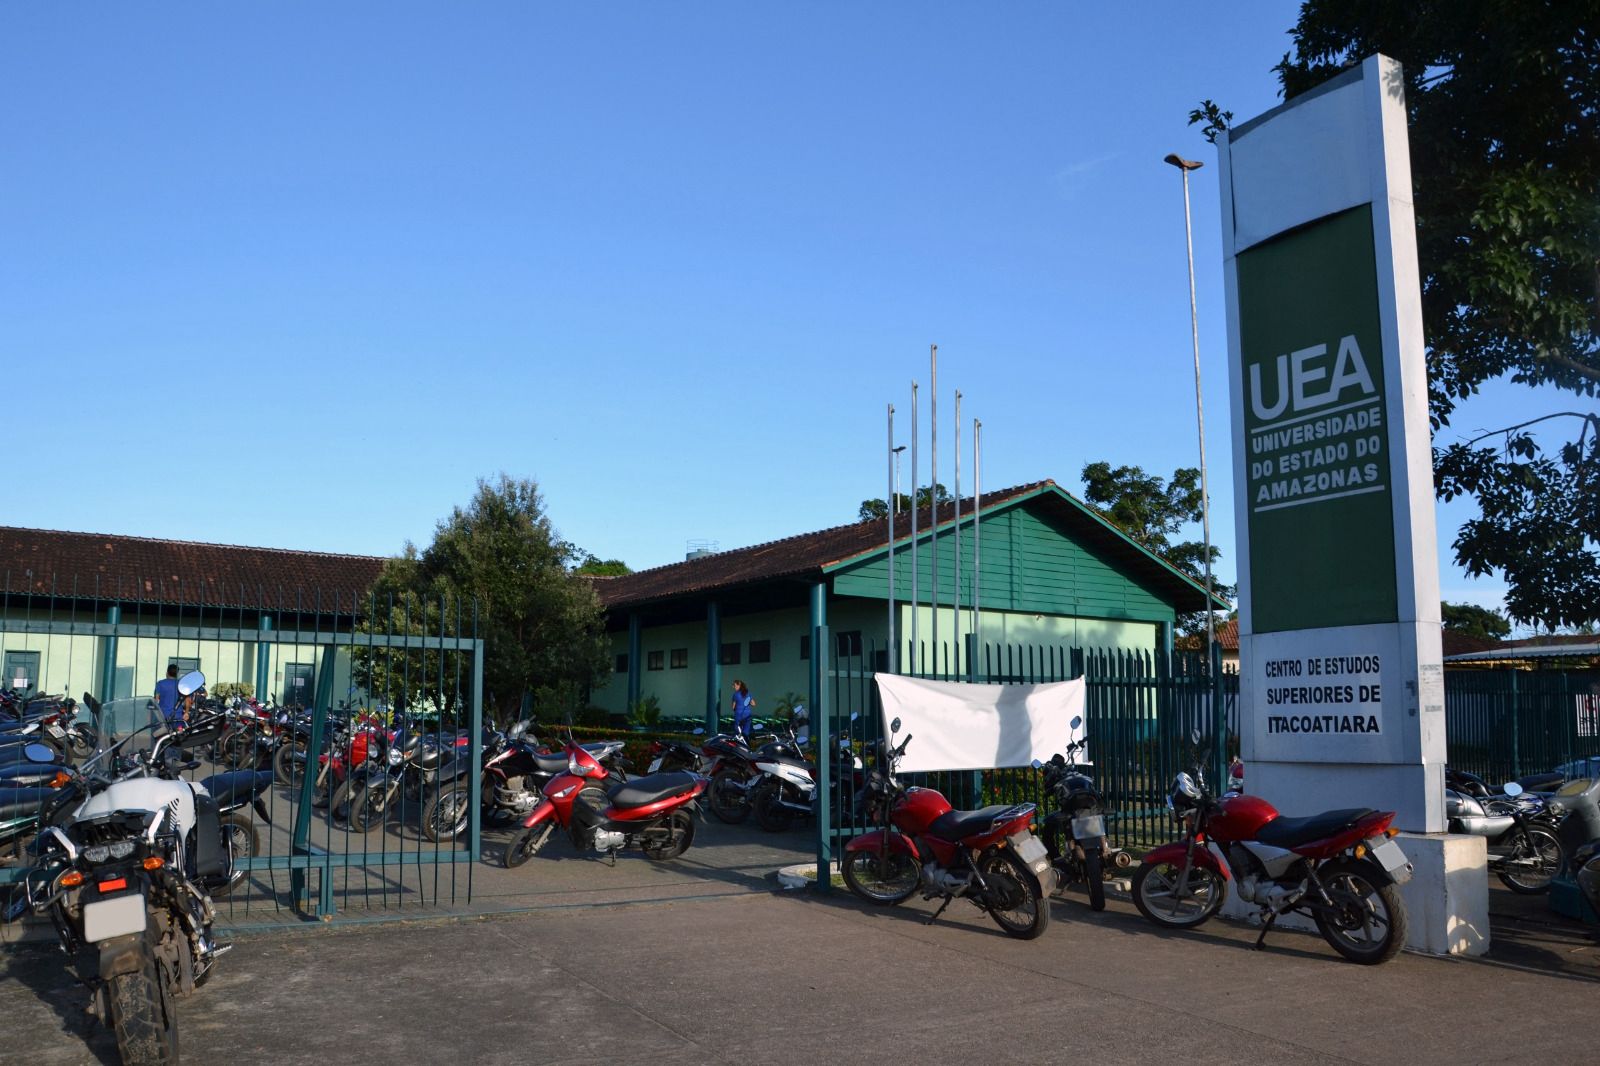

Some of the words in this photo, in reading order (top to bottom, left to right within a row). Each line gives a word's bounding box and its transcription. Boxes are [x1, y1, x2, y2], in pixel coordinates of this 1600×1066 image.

[1250, 334, 1375, 420] UEA
[1252, 407, 1381, 453] UNIVERSIDADE
[1252, 462, 1273, 480] DO
[1279, 442, 1348, 474] ESTADO
[1356, 435, 1380, 458] DO
[1257, 463, 1378, 502] AMAZONAS
[1266, 659, 1302, 678] CENTRO
[1308, 658, 1322, 675] DE
[1325, 655, 1380, 675] ESTUDOS
[1267, 685, 1354, 705] SUPERIORES
[1359, 685, 1381, 703] DE
[1268, 715, 1380, 734] ITACOATIARA
